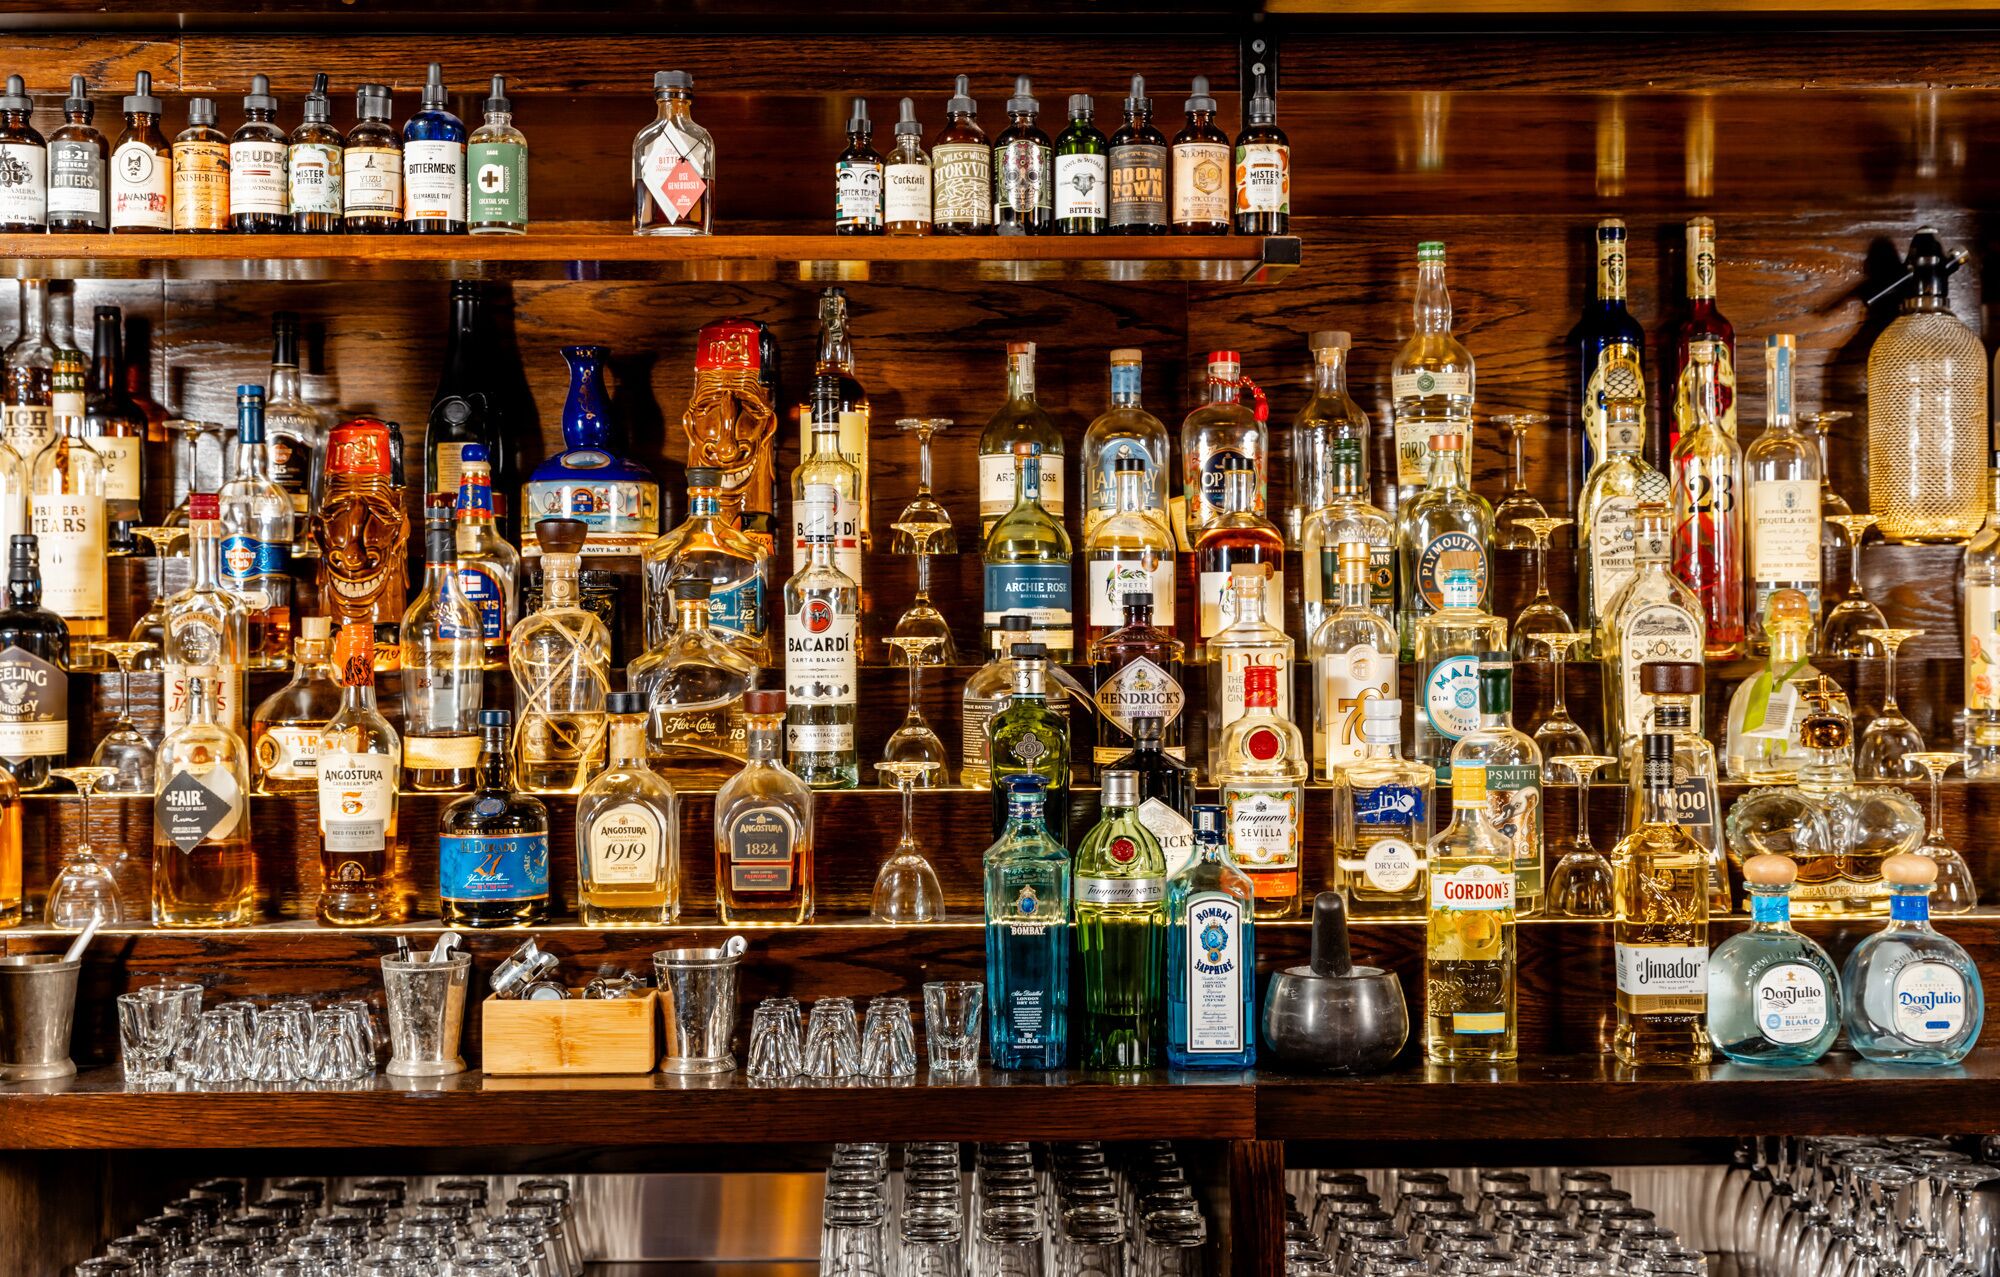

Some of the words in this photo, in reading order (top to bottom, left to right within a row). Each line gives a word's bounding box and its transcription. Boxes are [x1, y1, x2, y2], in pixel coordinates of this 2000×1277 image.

[234, 150, 282, 163] CRUDE
[296, 169, 324, 178] MISTER
[409, 162, 456, 174] BITTERMENS
[1250, 170, 1280, 178] MISTER
[54, 174, 94, 186] BITTERS
[678, 172, 688, 180] USE
[1113, 168, 1162, 184] BOOM
[668, 182, 700, 190] GENEROUSLY
[1113, 182, 1163, 200] TOWN
[35, 519, 86, 533] TEARS
[1005, 582, 1044, 592] ARCHIE
[1047, 582, 1067, 592] ROSE
[740, 609, 755, 620] 12
[789, 633, 850, 652] BACARDÍ
[1101, 692, 1180, 704] HENDRICK'S
[666, 718, 690, 734] Flor
[696, 717, 716, 733] Caña
[730, 728, 746, 740] 18
[325, 770, 383, 782] ANGOSTURA
[342, 792, 363, 814] 5
[1236, 810, 1287, 824] Tanqueray
[601, 826, 648, 836] ANGOSTURA
[740, 824, 783, 834] ANGOSTURA
[1242, 828, 1282, 837] SEVILLA
[602, 842, 646, 862] 1919
[745, 843, 778, 854] 1824
[473, 854, 503, 876] 21
[1088, 884, 1136, 898] Tanqueray
[1444, 881, 1509, 900] GORDON'S
[1802, 886, 1827, 896] GRAN
[1830, 885, 1877, 896] CORRALEJO
[1196, 907, 1233, 924] BOMBAY
[1010, 926, 1046, 936] BOMBAY
[1194, 958, 1234, 975] SAPPHIRE
[1636, 961, 1643, 972] el
[1639, 956, 1702, 984] Jimador
[1786, 1018, 1820, 1026] BLANCO
